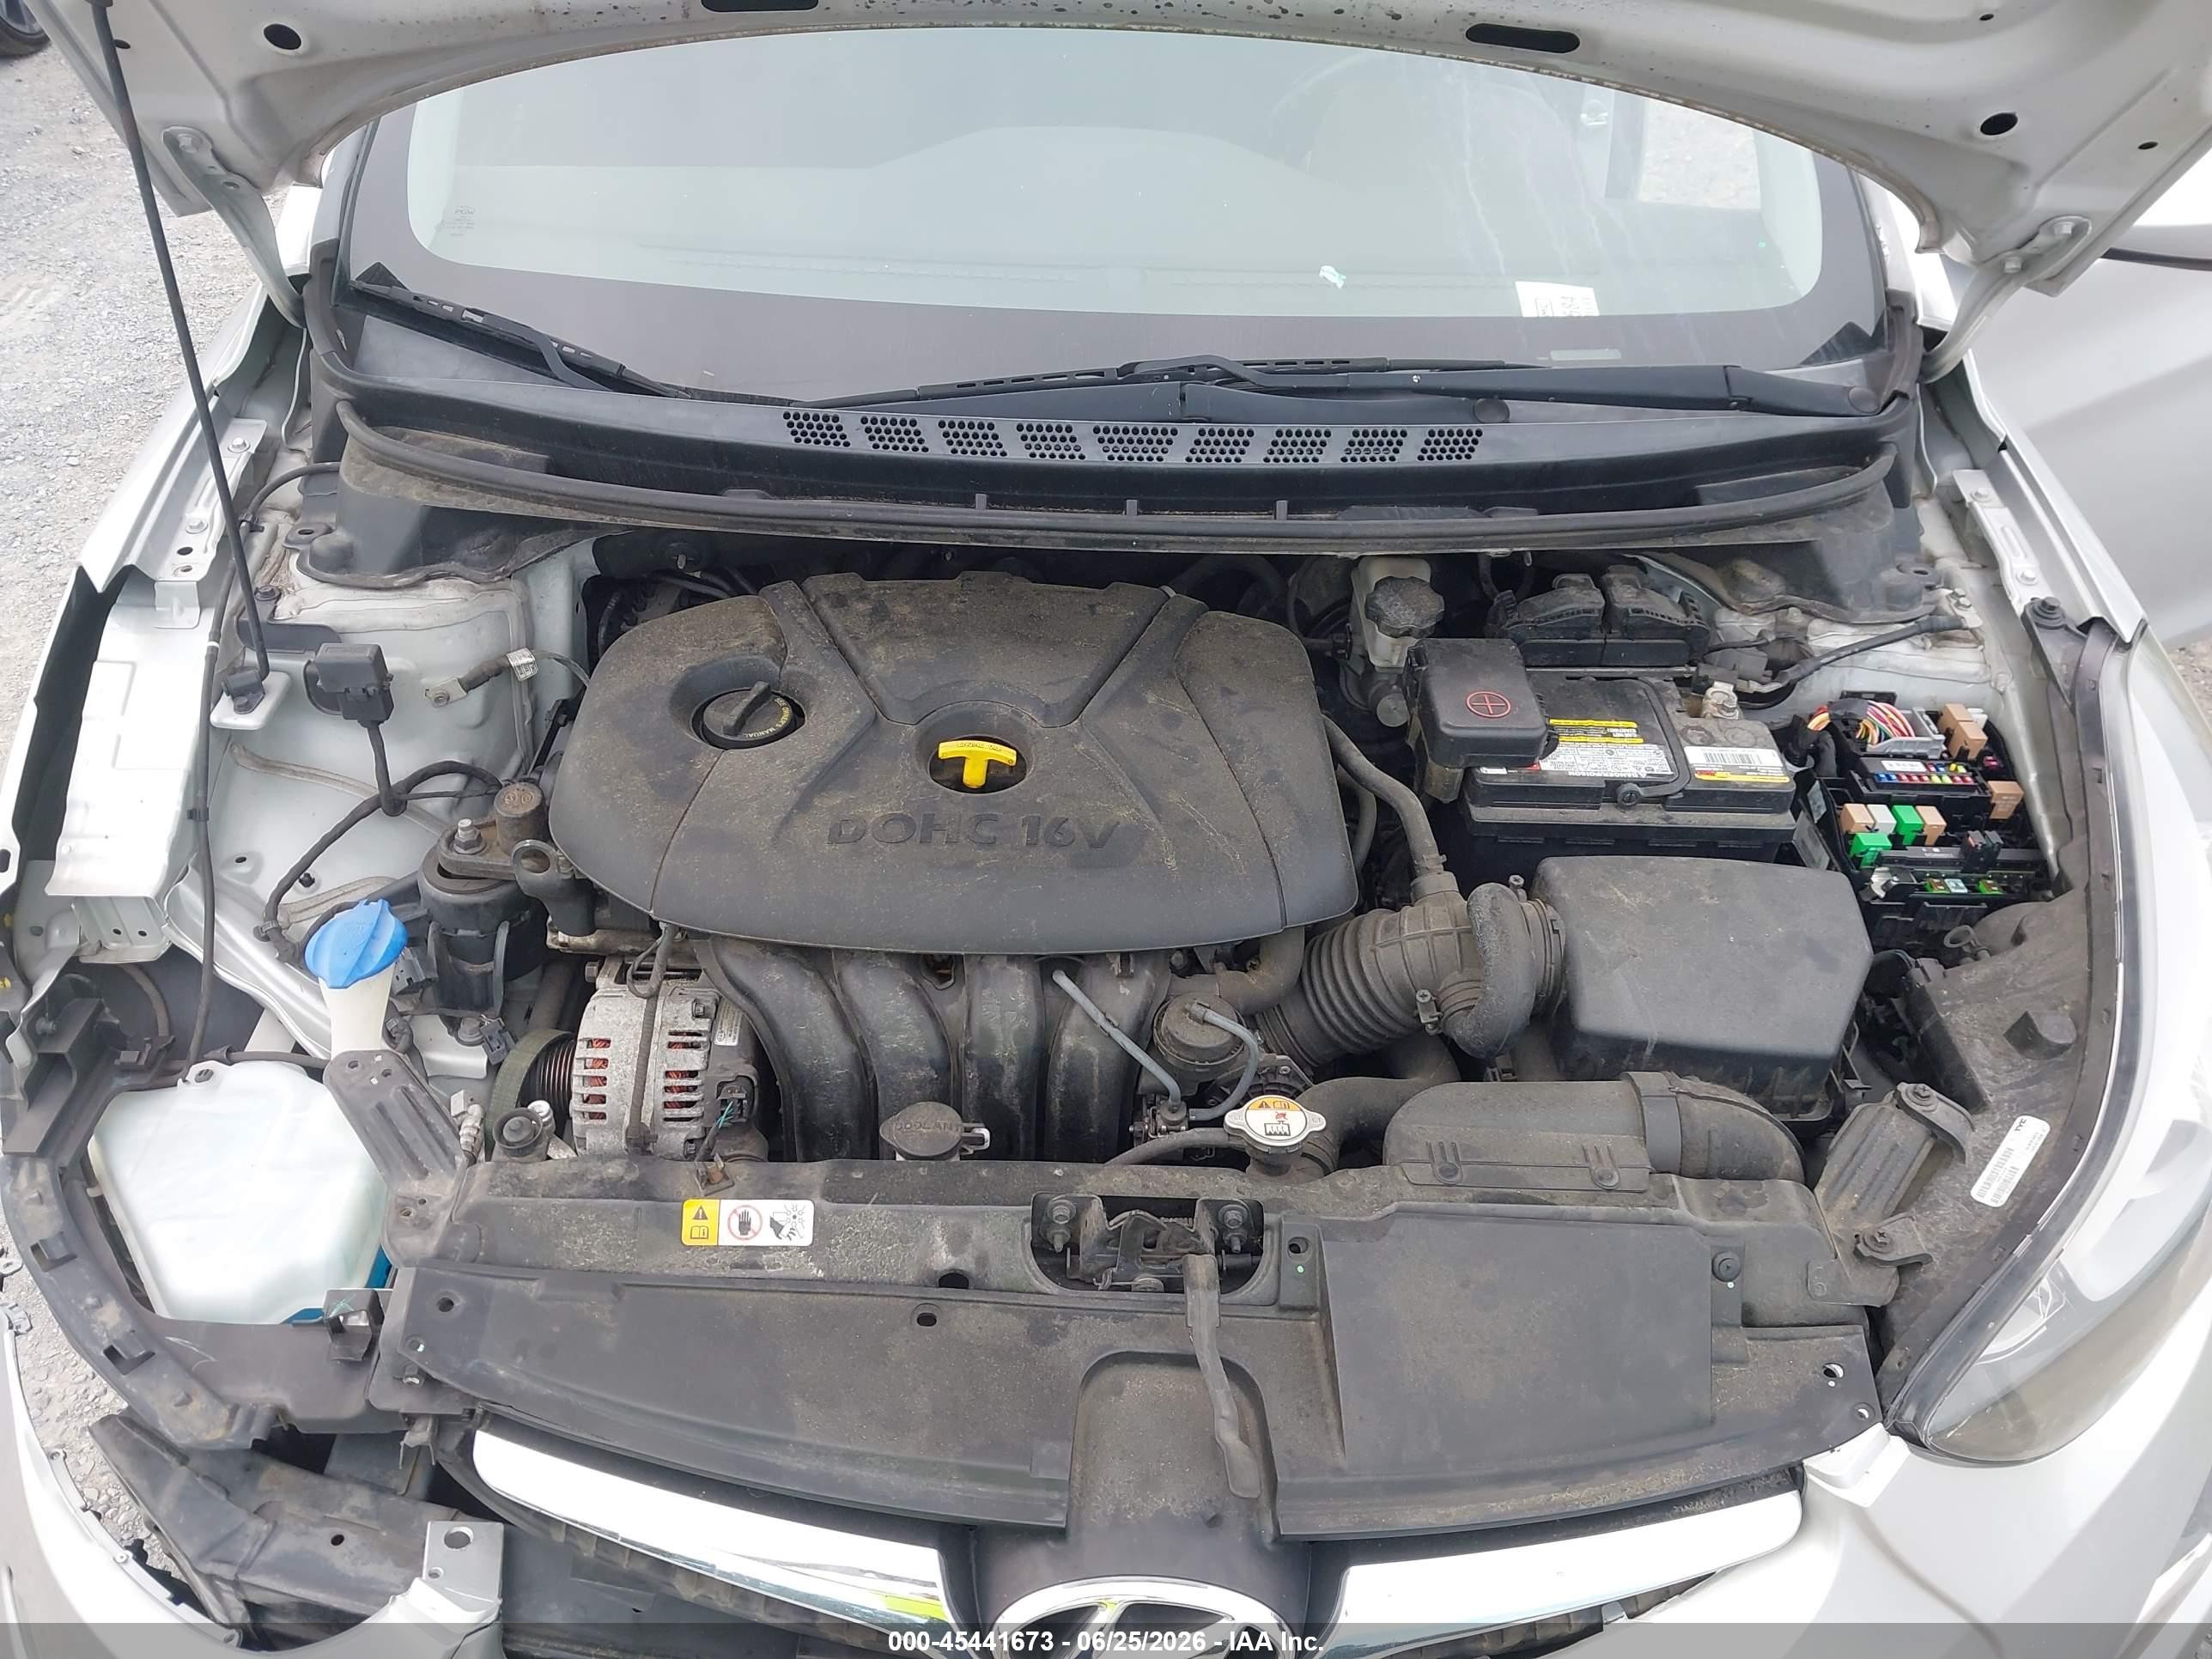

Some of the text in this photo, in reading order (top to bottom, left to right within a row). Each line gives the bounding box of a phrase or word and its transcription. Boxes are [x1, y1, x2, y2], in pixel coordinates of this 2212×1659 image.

[744, 728, 776, 738] MANUAL
[827, 812, 1121, 849] DOHC 16V
